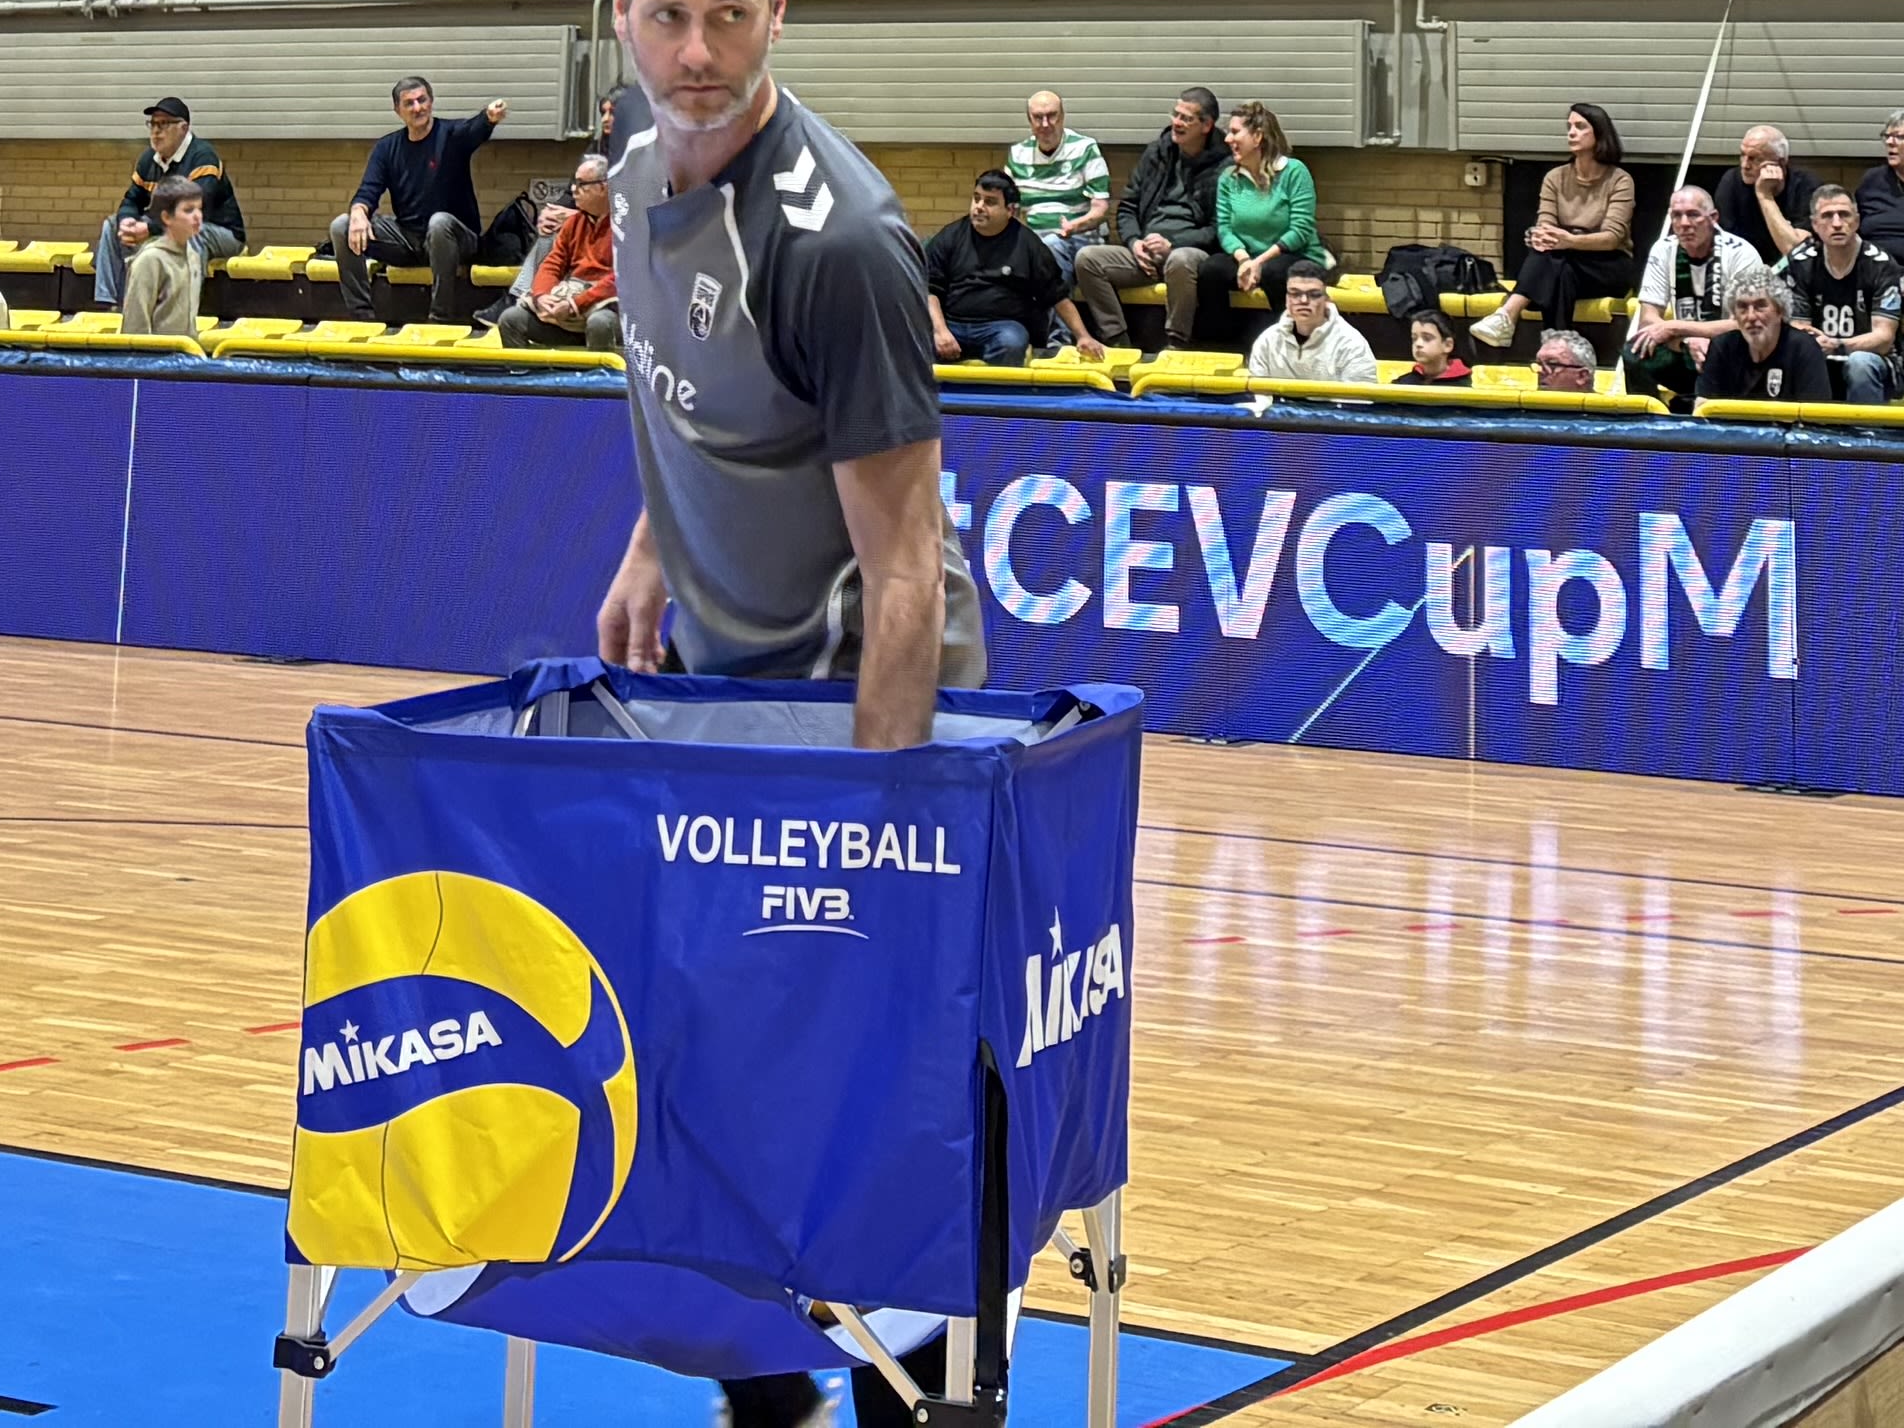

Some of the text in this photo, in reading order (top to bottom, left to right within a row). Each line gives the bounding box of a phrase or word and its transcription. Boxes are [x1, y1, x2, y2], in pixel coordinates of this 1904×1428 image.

[1822, 304, 1855, 337] 86
[656, 813, 962, 875] VOLLEYBALL
[761, 884, 854, 922] FIVB
